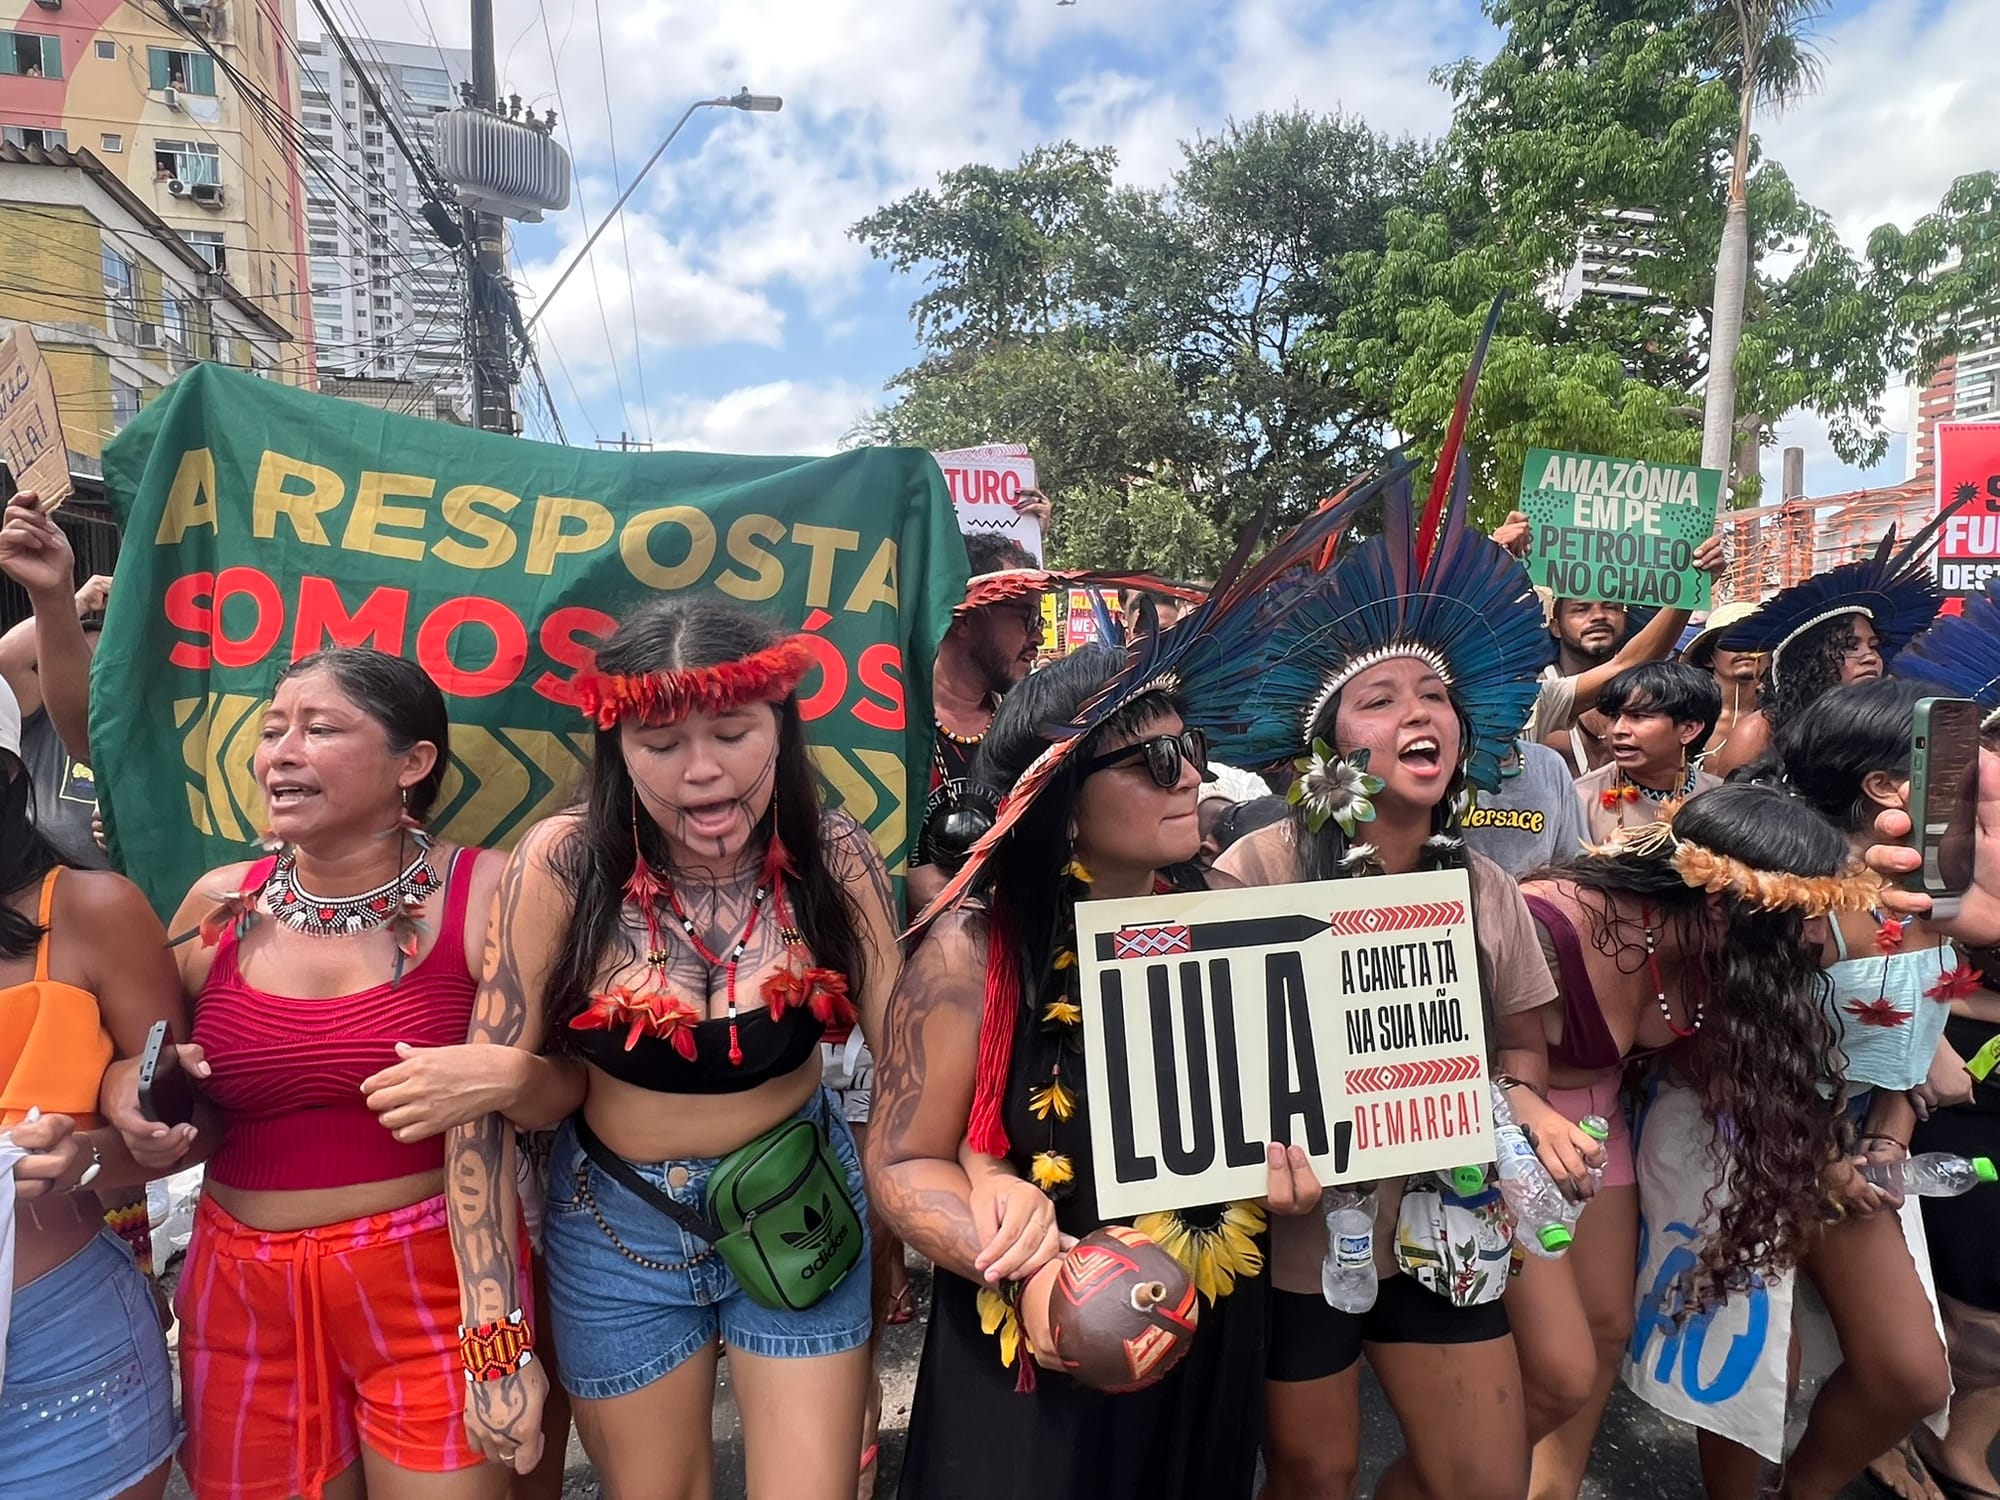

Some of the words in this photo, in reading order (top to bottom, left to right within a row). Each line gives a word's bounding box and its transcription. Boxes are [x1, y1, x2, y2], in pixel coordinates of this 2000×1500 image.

[1538, 456, 1699, 506] AMAZÔNIA
[154, 447, 218, 546] A
[252, 449, 899, 613] RESPOSTA
[1573, 493, 1619, 531] EM
[1625, 495, 1662, 535] PÉ
[1945, 515, 2000, 555] FU
[1539, 525, 1692, 572] PETRÓLEO
[1546, 560, 1591, 596] NO
[1598, 563, 1682, 605] CHÃO
[164, 566, 620, 707] SOMOS
[1342, 949, 1355, 995] A
[1359, 941, 1432, 993] CANETA
[1436, 928, 1458, 984] TÁ
[1346, 1008, 1376, 1055] NA
[1378, 1003, 1416, 1052] SUA
[1419, 988, 1470, 1047] MÃO.
[1099, 951, 1353, 1184] LULA,
[1354, 1089, 1482, 1151] DEMARCA!
[801, 1225, 850, 1281] adidas
